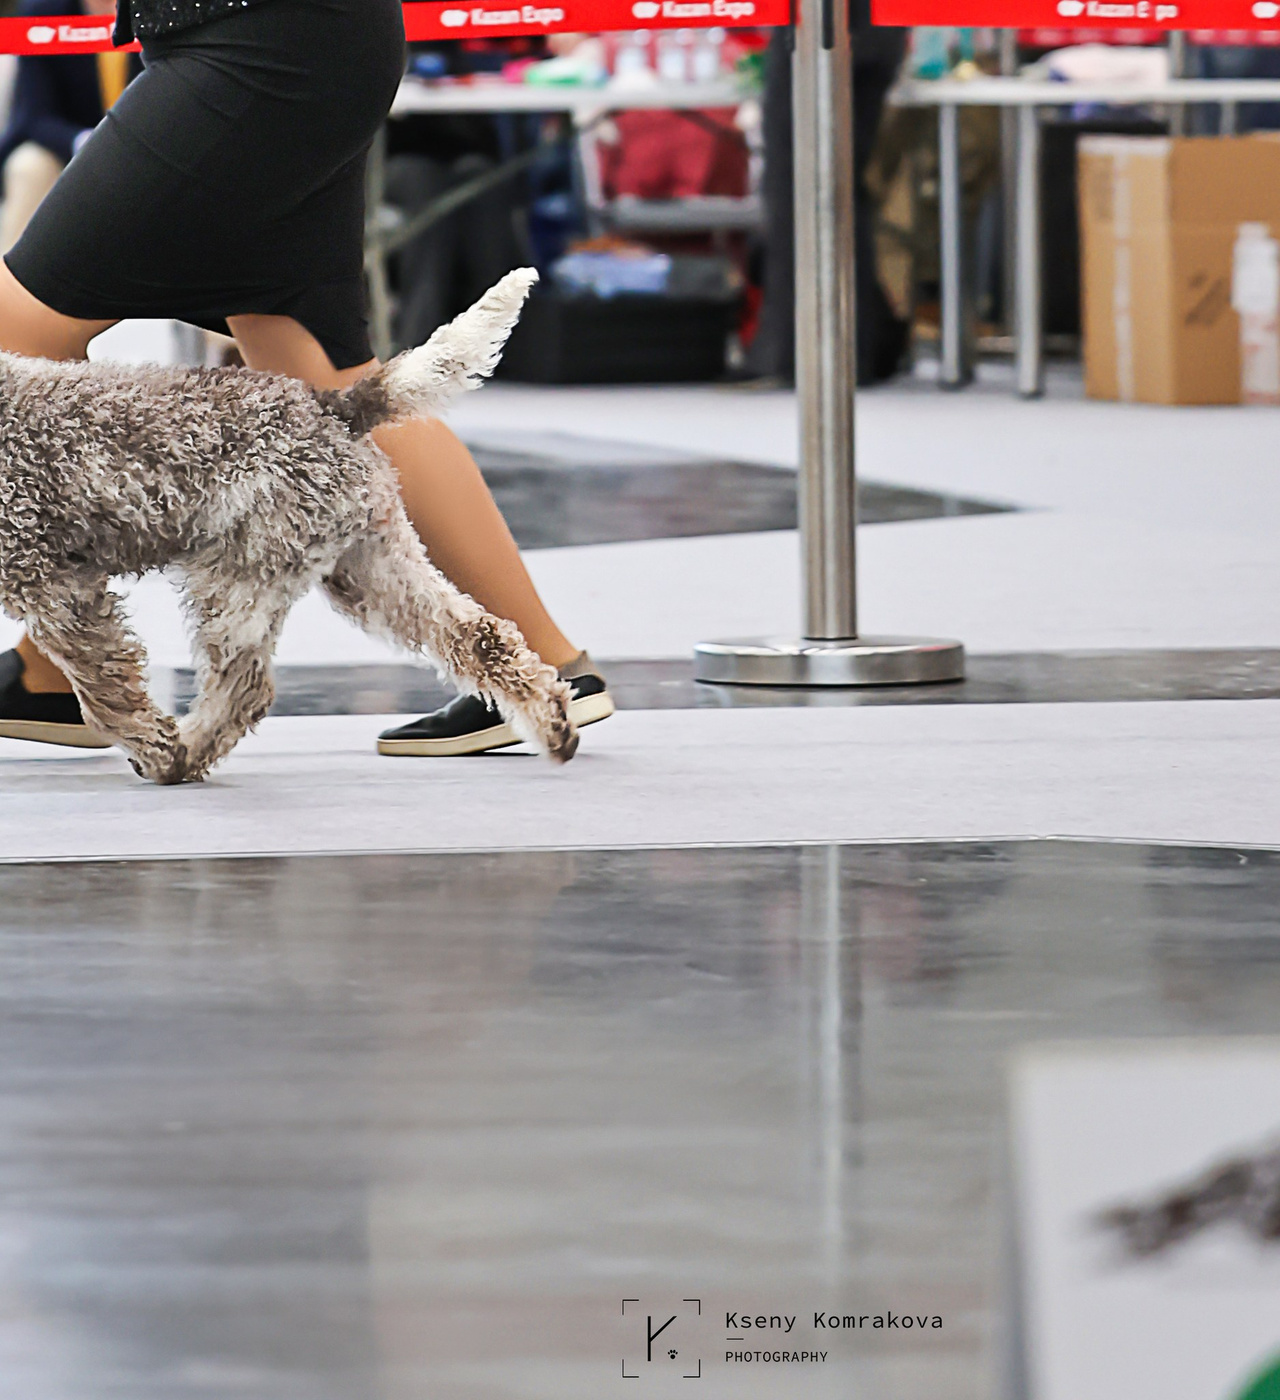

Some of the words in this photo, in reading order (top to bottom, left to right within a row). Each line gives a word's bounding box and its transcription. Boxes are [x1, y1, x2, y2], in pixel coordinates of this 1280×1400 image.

[470, 8, 520, 25] Kazan
[521, 5, 564, 26] Expo
[661, 1, 712, 18] Kazan
[1087, 1, 1135, 18] Kazan
[58, 25, 109, 42] Kazan
